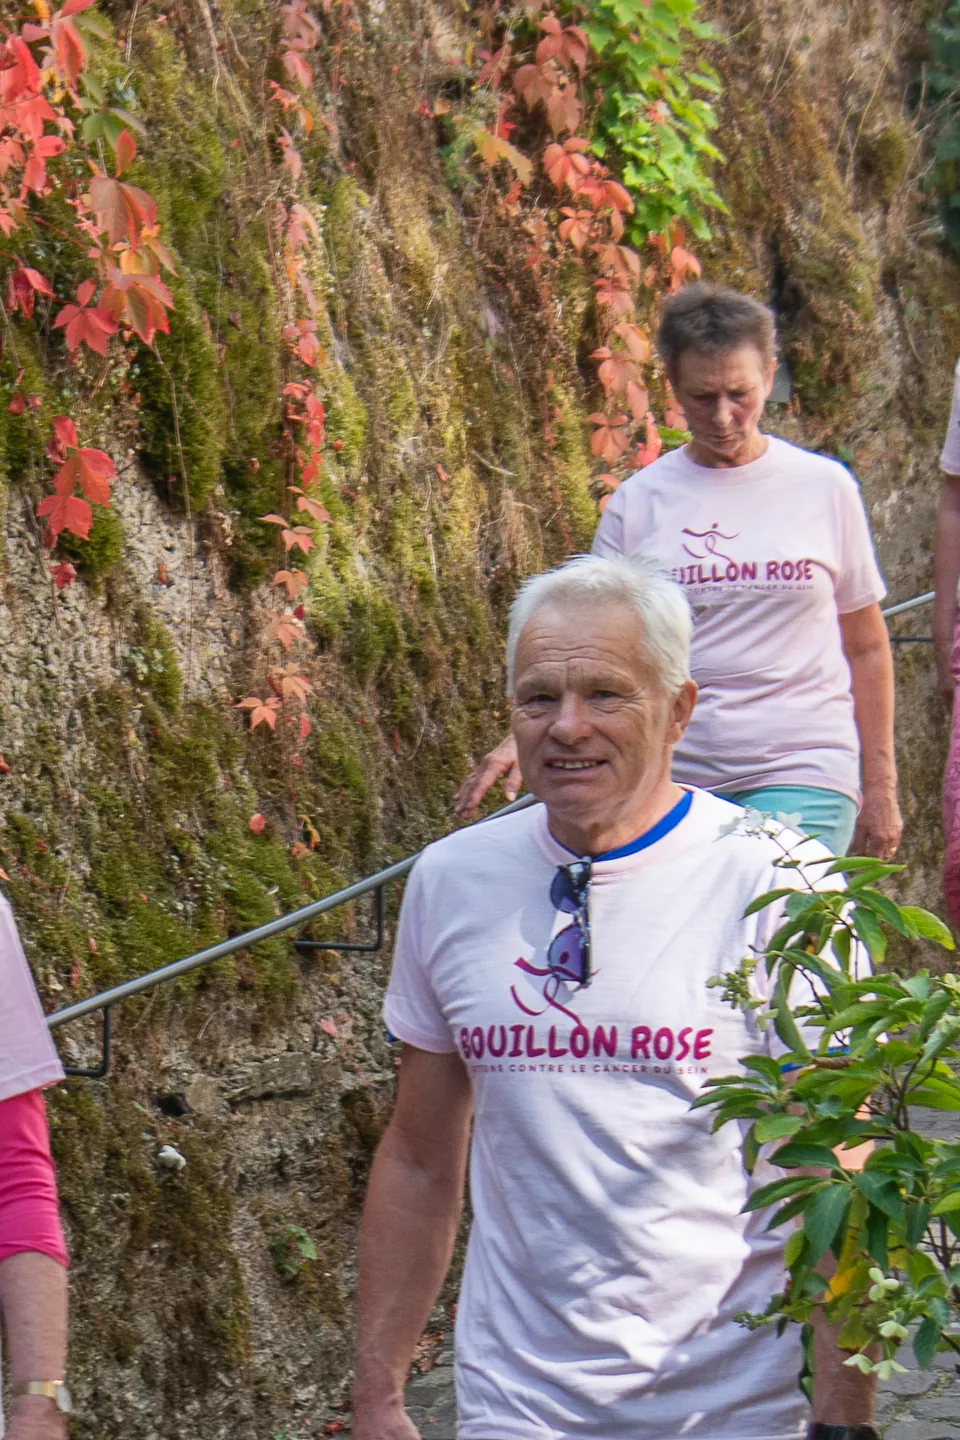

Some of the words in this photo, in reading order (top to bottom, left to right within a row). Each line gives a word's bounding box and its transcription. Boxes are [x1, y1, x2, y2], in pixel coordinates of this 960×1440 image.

[766, 559, 814, 582] ROSE
[460, 1024, 618, 1060] BOUILLON
[631, 1025, 715, 1062] ROSE
[509, 1063, 565, 1074] CONTRE
[571, 1063, 587, 1074] LE
[593, 1064, 648, 1074] CANCER
[654, 1065, 672, 1075] DU
[677, 1065, 709, 1075] SEIN
